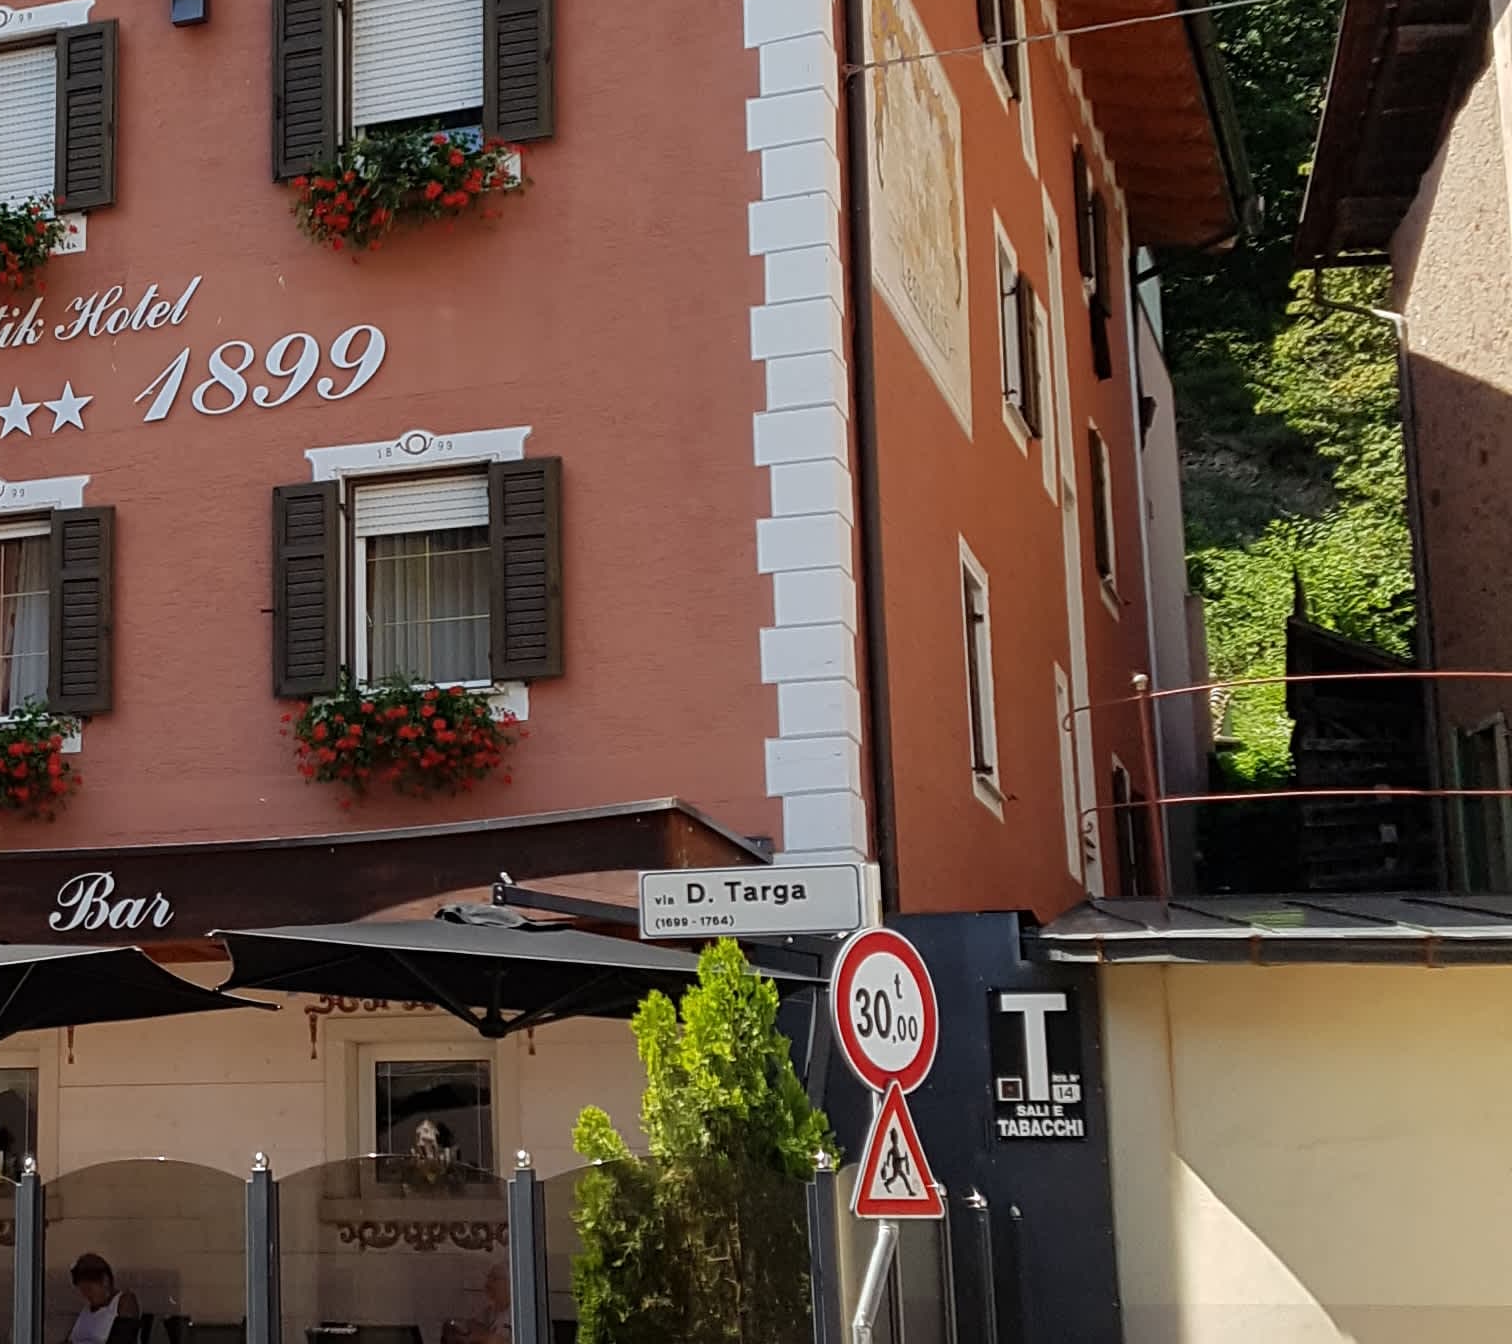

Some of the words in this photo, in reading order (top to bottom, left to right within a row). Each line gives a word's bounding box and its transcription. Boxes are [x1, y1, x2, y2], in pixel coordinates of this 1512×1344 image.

[55, 275, 203, 340] Hotel
[133, 324, 387, 423] 1899
[48, 871, 174, 931] Bar
[655, 894, 675, 905] via
[687, 883, 714, 904] D.
[724, 881, 807, 905] Targa
[894, 973, 903, 999] t
[1000, 994, 1067, 1101] T
[997, 1119, 1084, 1136] TABACCHI
[1016, 1105, 1049, 1116] SALI
